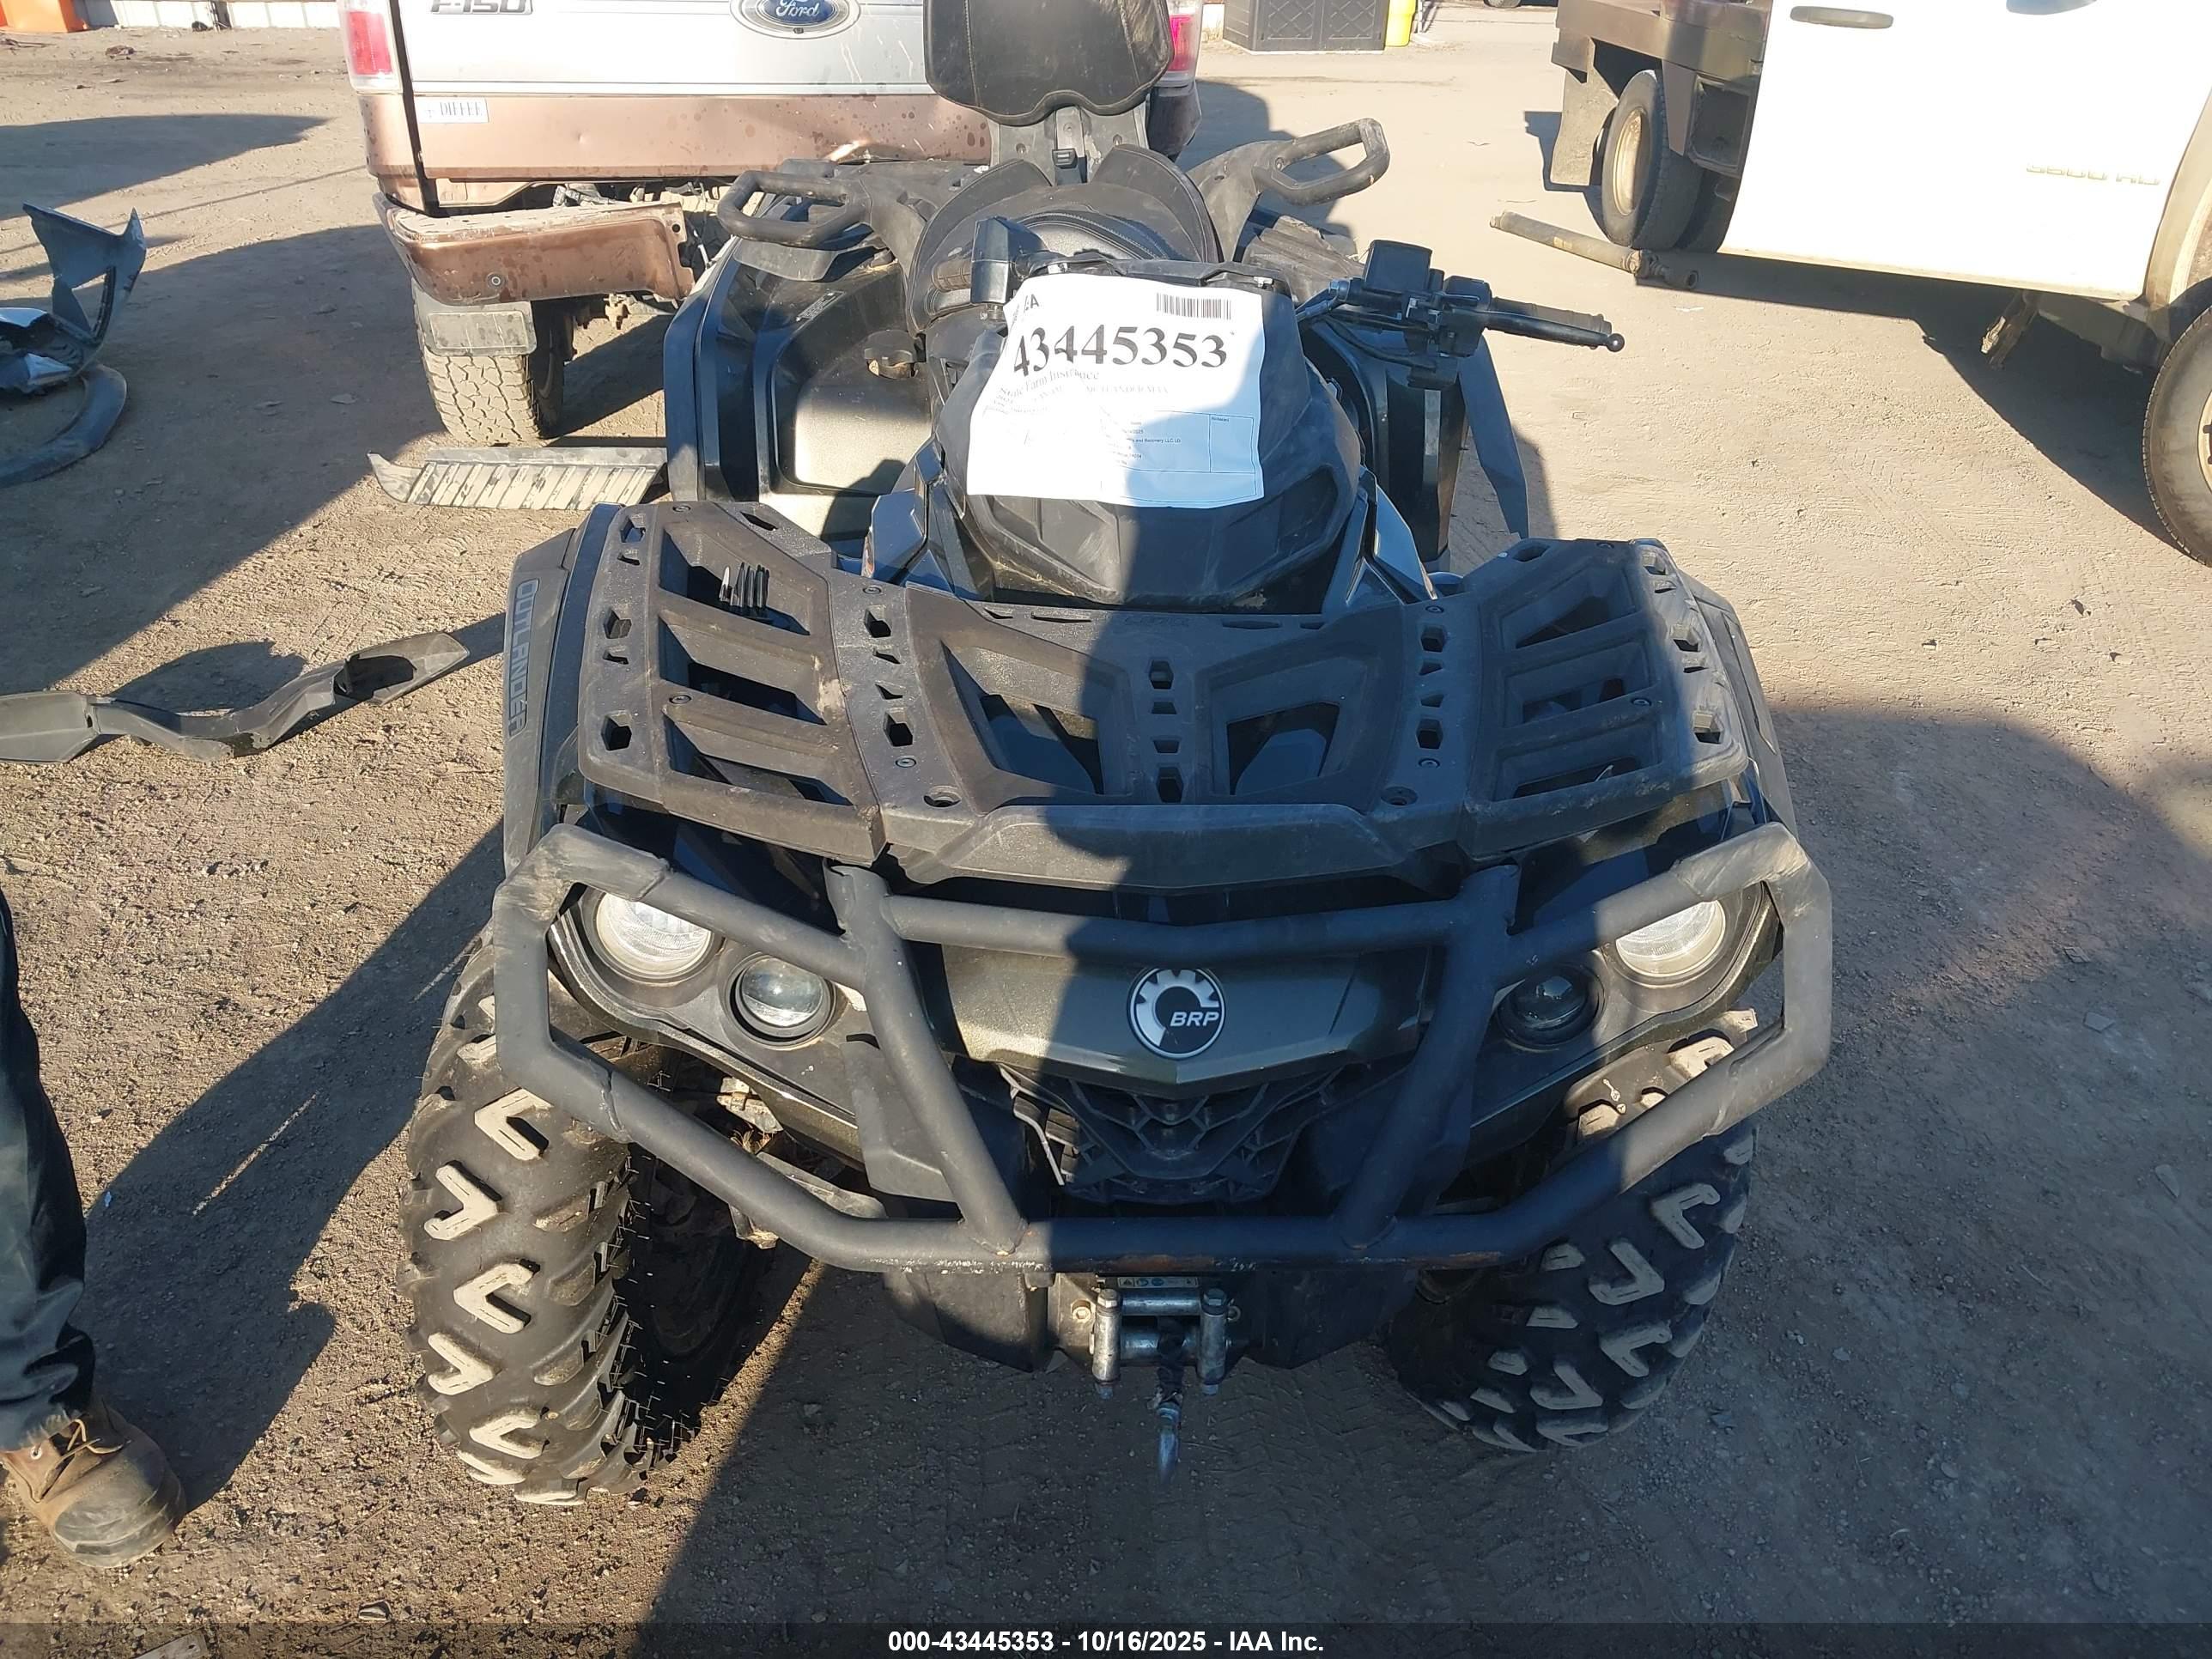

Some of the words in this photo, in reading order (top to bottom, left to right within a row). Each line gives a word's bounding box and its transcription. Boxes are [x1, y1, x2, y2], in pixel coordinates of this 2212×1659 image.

[431, 0, 526, 13] F-150
[775, 0, 819, 16] Ford
[1013, 324, 1227, 376] 43445353
[508, 580, 539, 737] OUTLANDER
[1170, 1011, 1220, 1027] BRP
